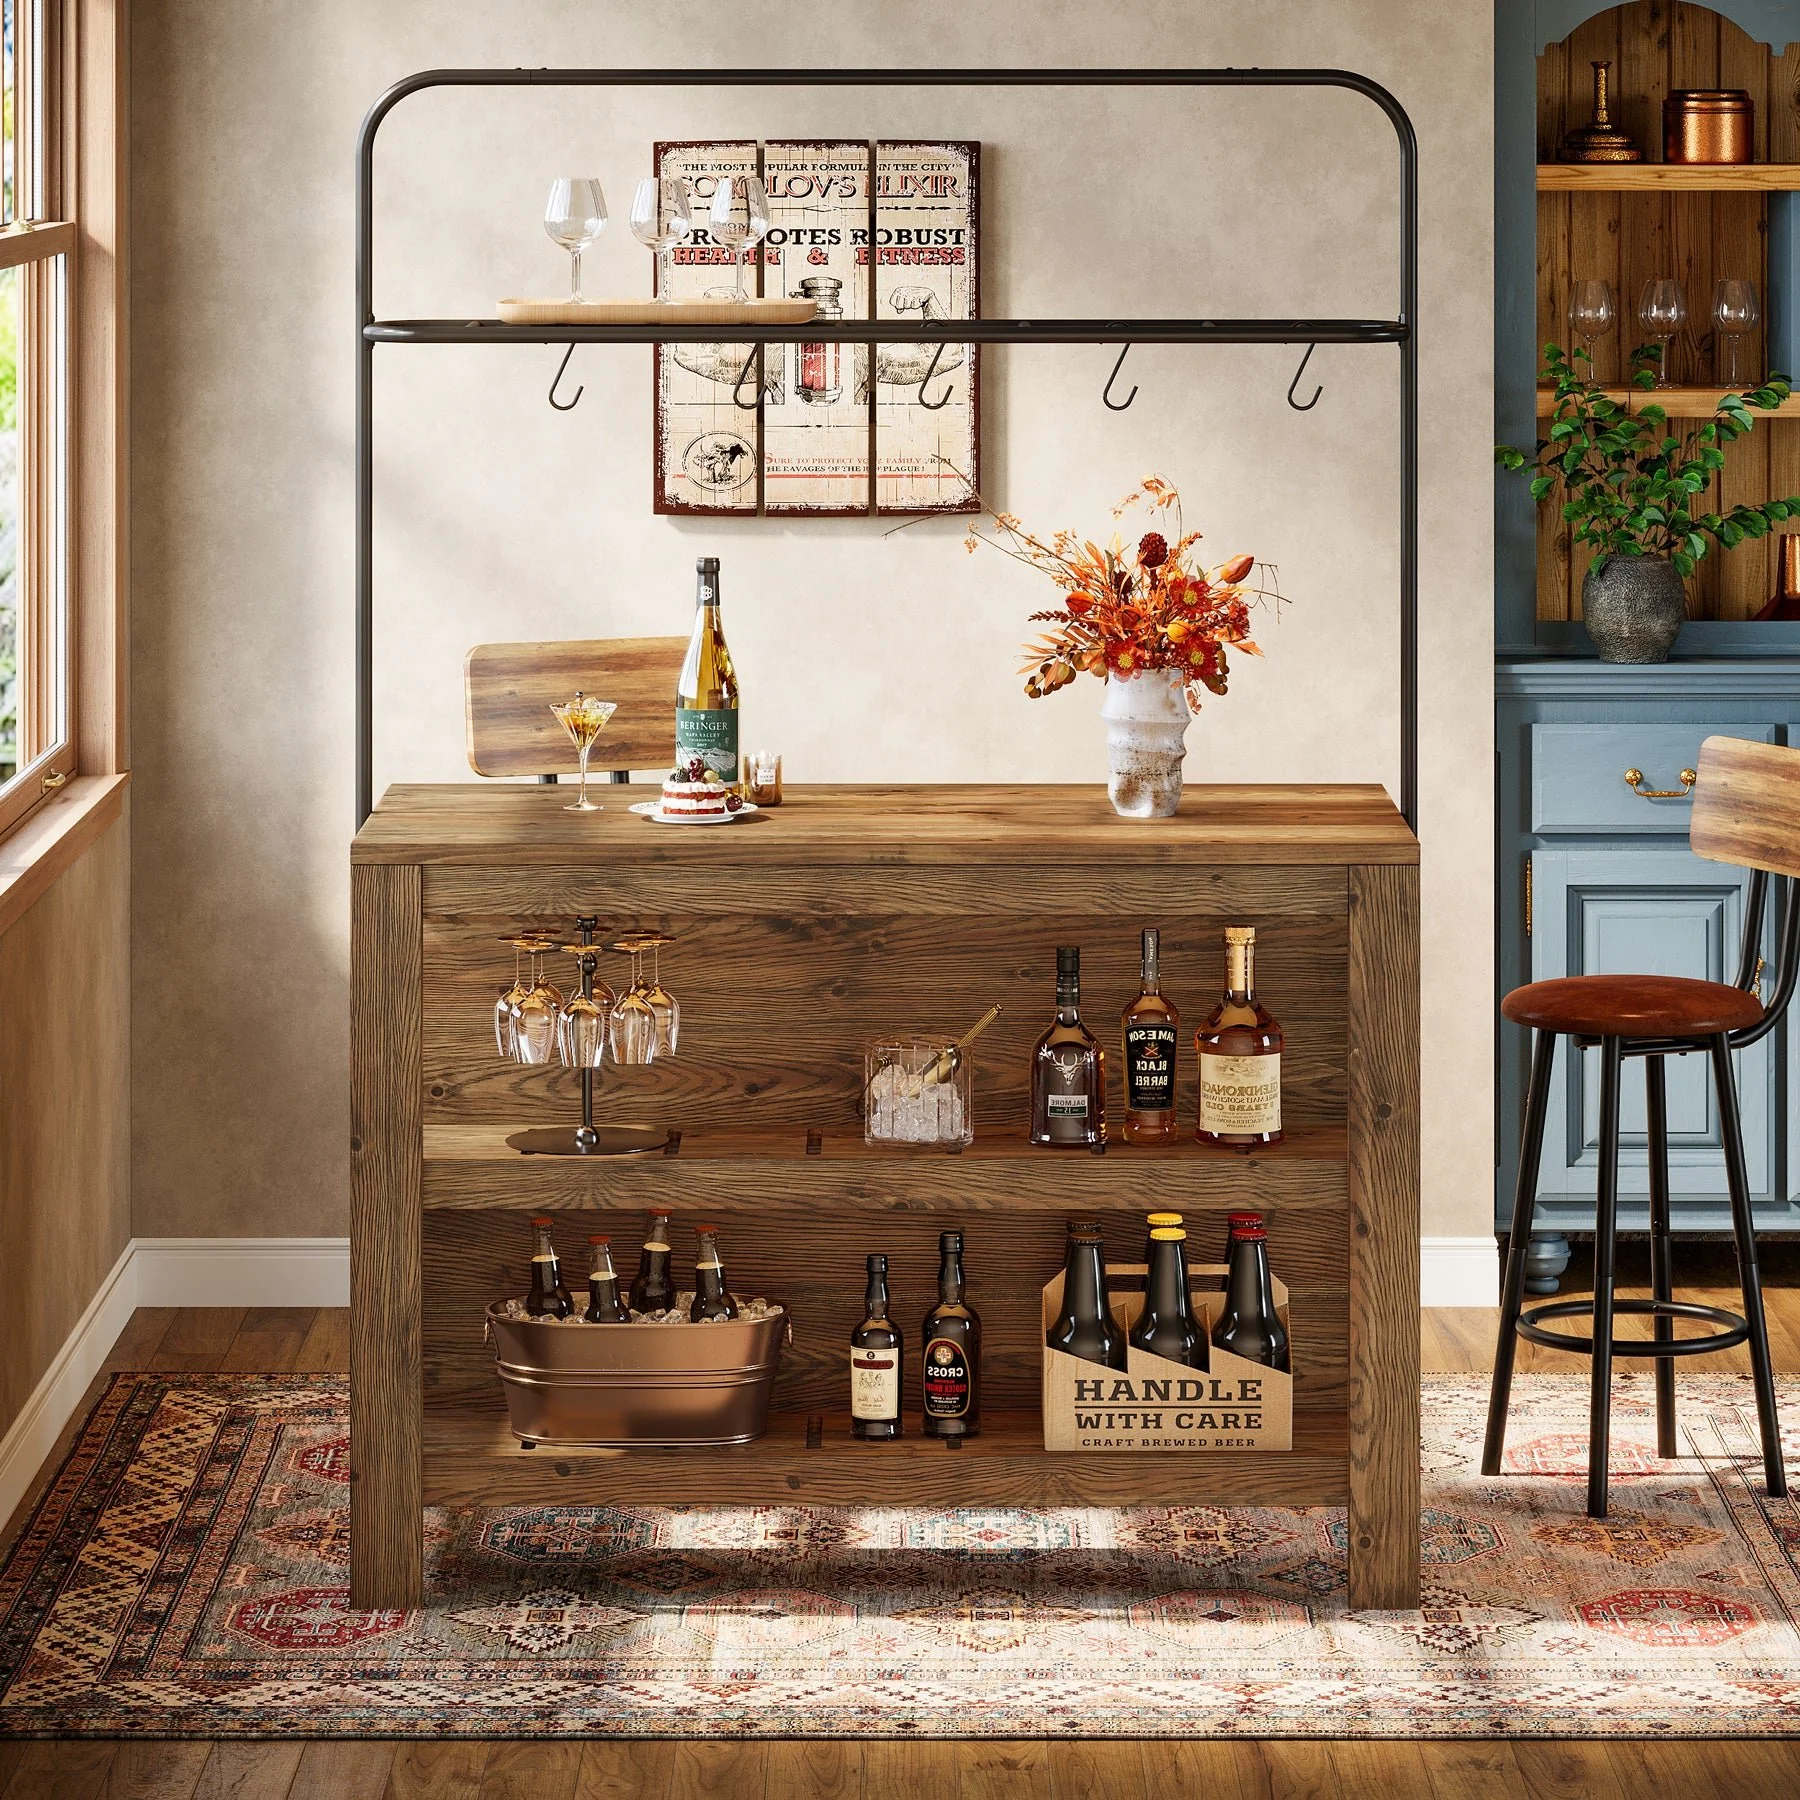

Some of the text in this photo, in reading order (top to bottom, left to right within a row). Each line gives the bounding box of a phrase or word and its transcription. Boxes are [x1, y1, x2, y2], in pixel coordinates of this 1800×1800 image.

[710, 163, 747, 171] MOST
[750, 163, 808, 171] PPULAR
[893, 163, 918, 171] THE
[681, 174, 857, 198] SOKLOV'S
[674, 228, 966, 245] ROTES ROBUST
[806, 247, 829, 265] &
[856, 247, 966, 265] FITNESS
[680, 720, 728, 730] BERINGER
[1074, 1379, 1262, 1401] HANDLE
[1074, 1413, 1262, 1429] WITH CARE
[1082, 1438, 1256, 1447] CRAFT BREWED BEER
